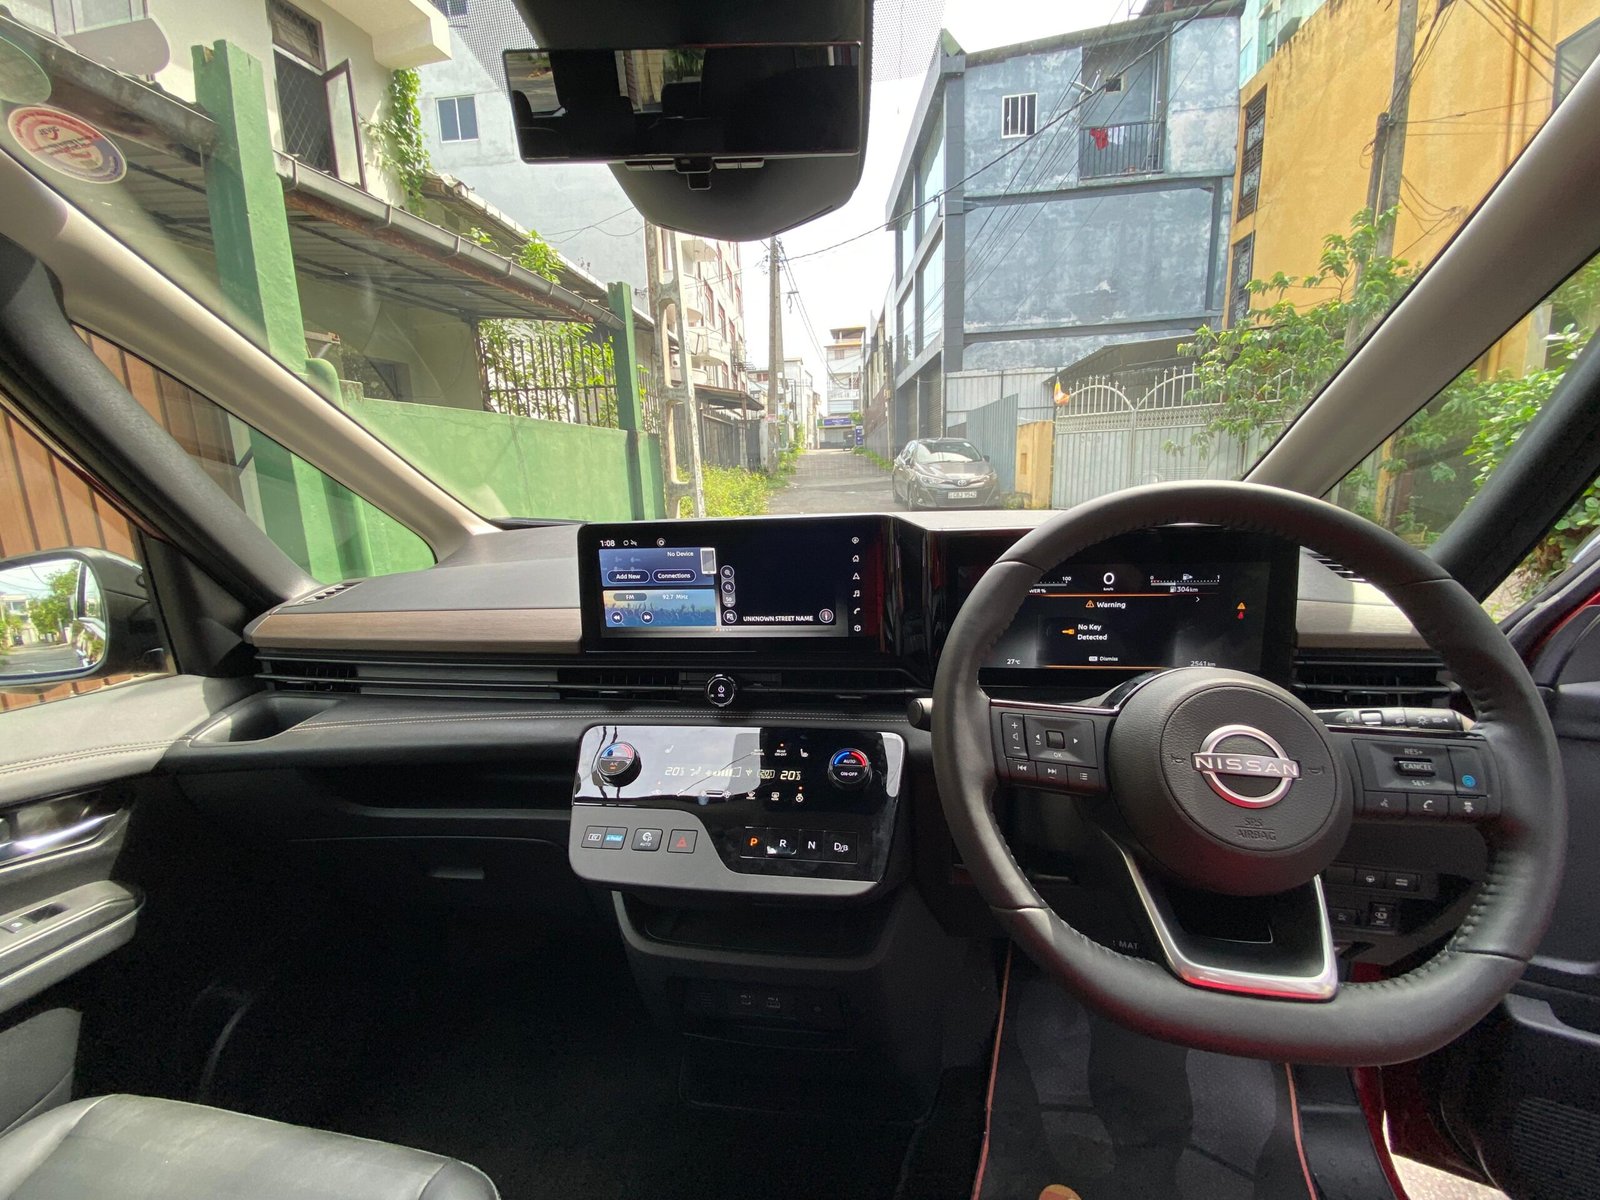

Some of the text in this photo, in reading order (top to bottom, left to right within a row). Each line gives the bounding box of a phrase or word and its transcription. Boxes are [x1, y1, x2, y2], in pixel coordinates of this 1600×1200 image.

[1103, 572, 1114, 585] 0
[1194, 756, 1297, 776] NISSAN
[1244, 817, 1262, 827] SRS
[1238, 829, 1276, 840] AIRBAG
[750, 838, 758, 846] P
[808, 841, 816, 849] N
